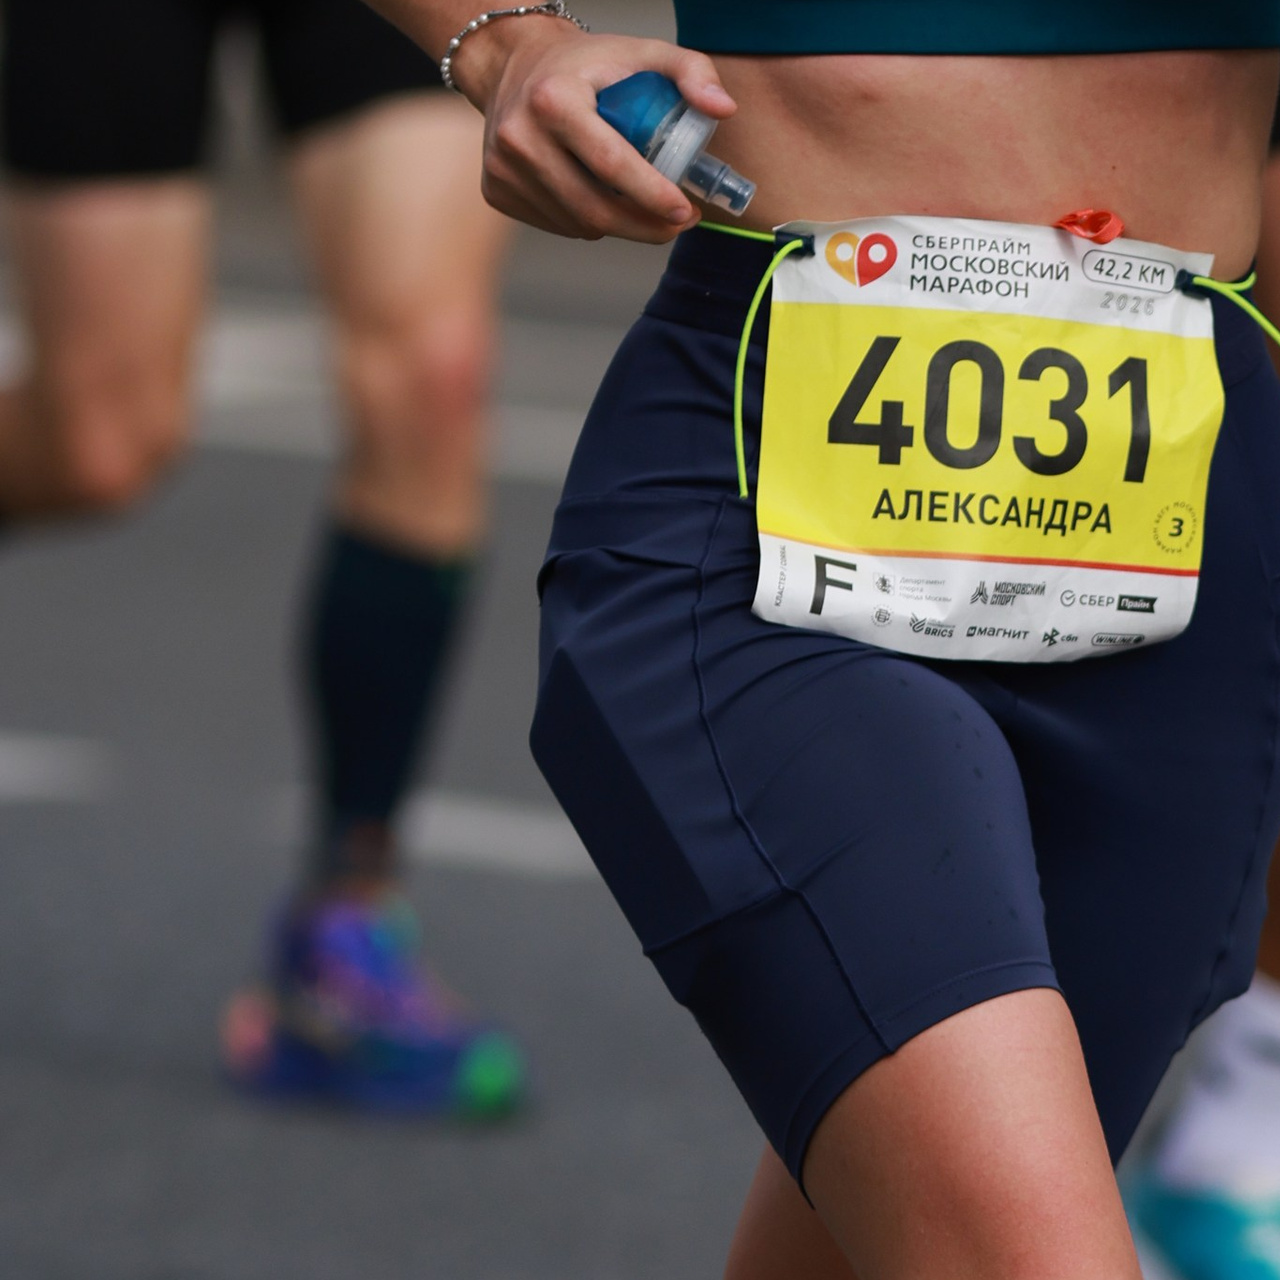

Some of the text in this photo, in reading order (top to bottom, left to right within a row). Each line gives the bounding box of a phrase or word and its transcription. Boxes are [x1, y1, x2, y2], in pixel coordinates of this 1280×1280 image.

[912, 234, 1031, 255] СБЕРПРАЙМ
[911, 253, 1070, 282] МОСКОВСКИЙ
[1093, 257, 1166, 286] 42,2 КМ
[909, 275, 1029, 298] МАРАФОН
[1100, 291, 1155, 316] 2026
[826, 335, 1152, 484] 4031
[872, 488, 1113, 536] АЛЕКСАНДРА
[1168, 517, 1184, 537] 3
[774, 570, 787, 607] КЛАСТЕР
[809, 554, 857, 616] F
[993, 581, 1047, 596] МОСКОВСКИЙ
[990, 594, 1017, 606] СПОРТ
[1079, 594, 1150, 609] СБЕР Прайм
[924, 626, 954, 638] BRICS
[977, 626, 1030, 640] магнит
